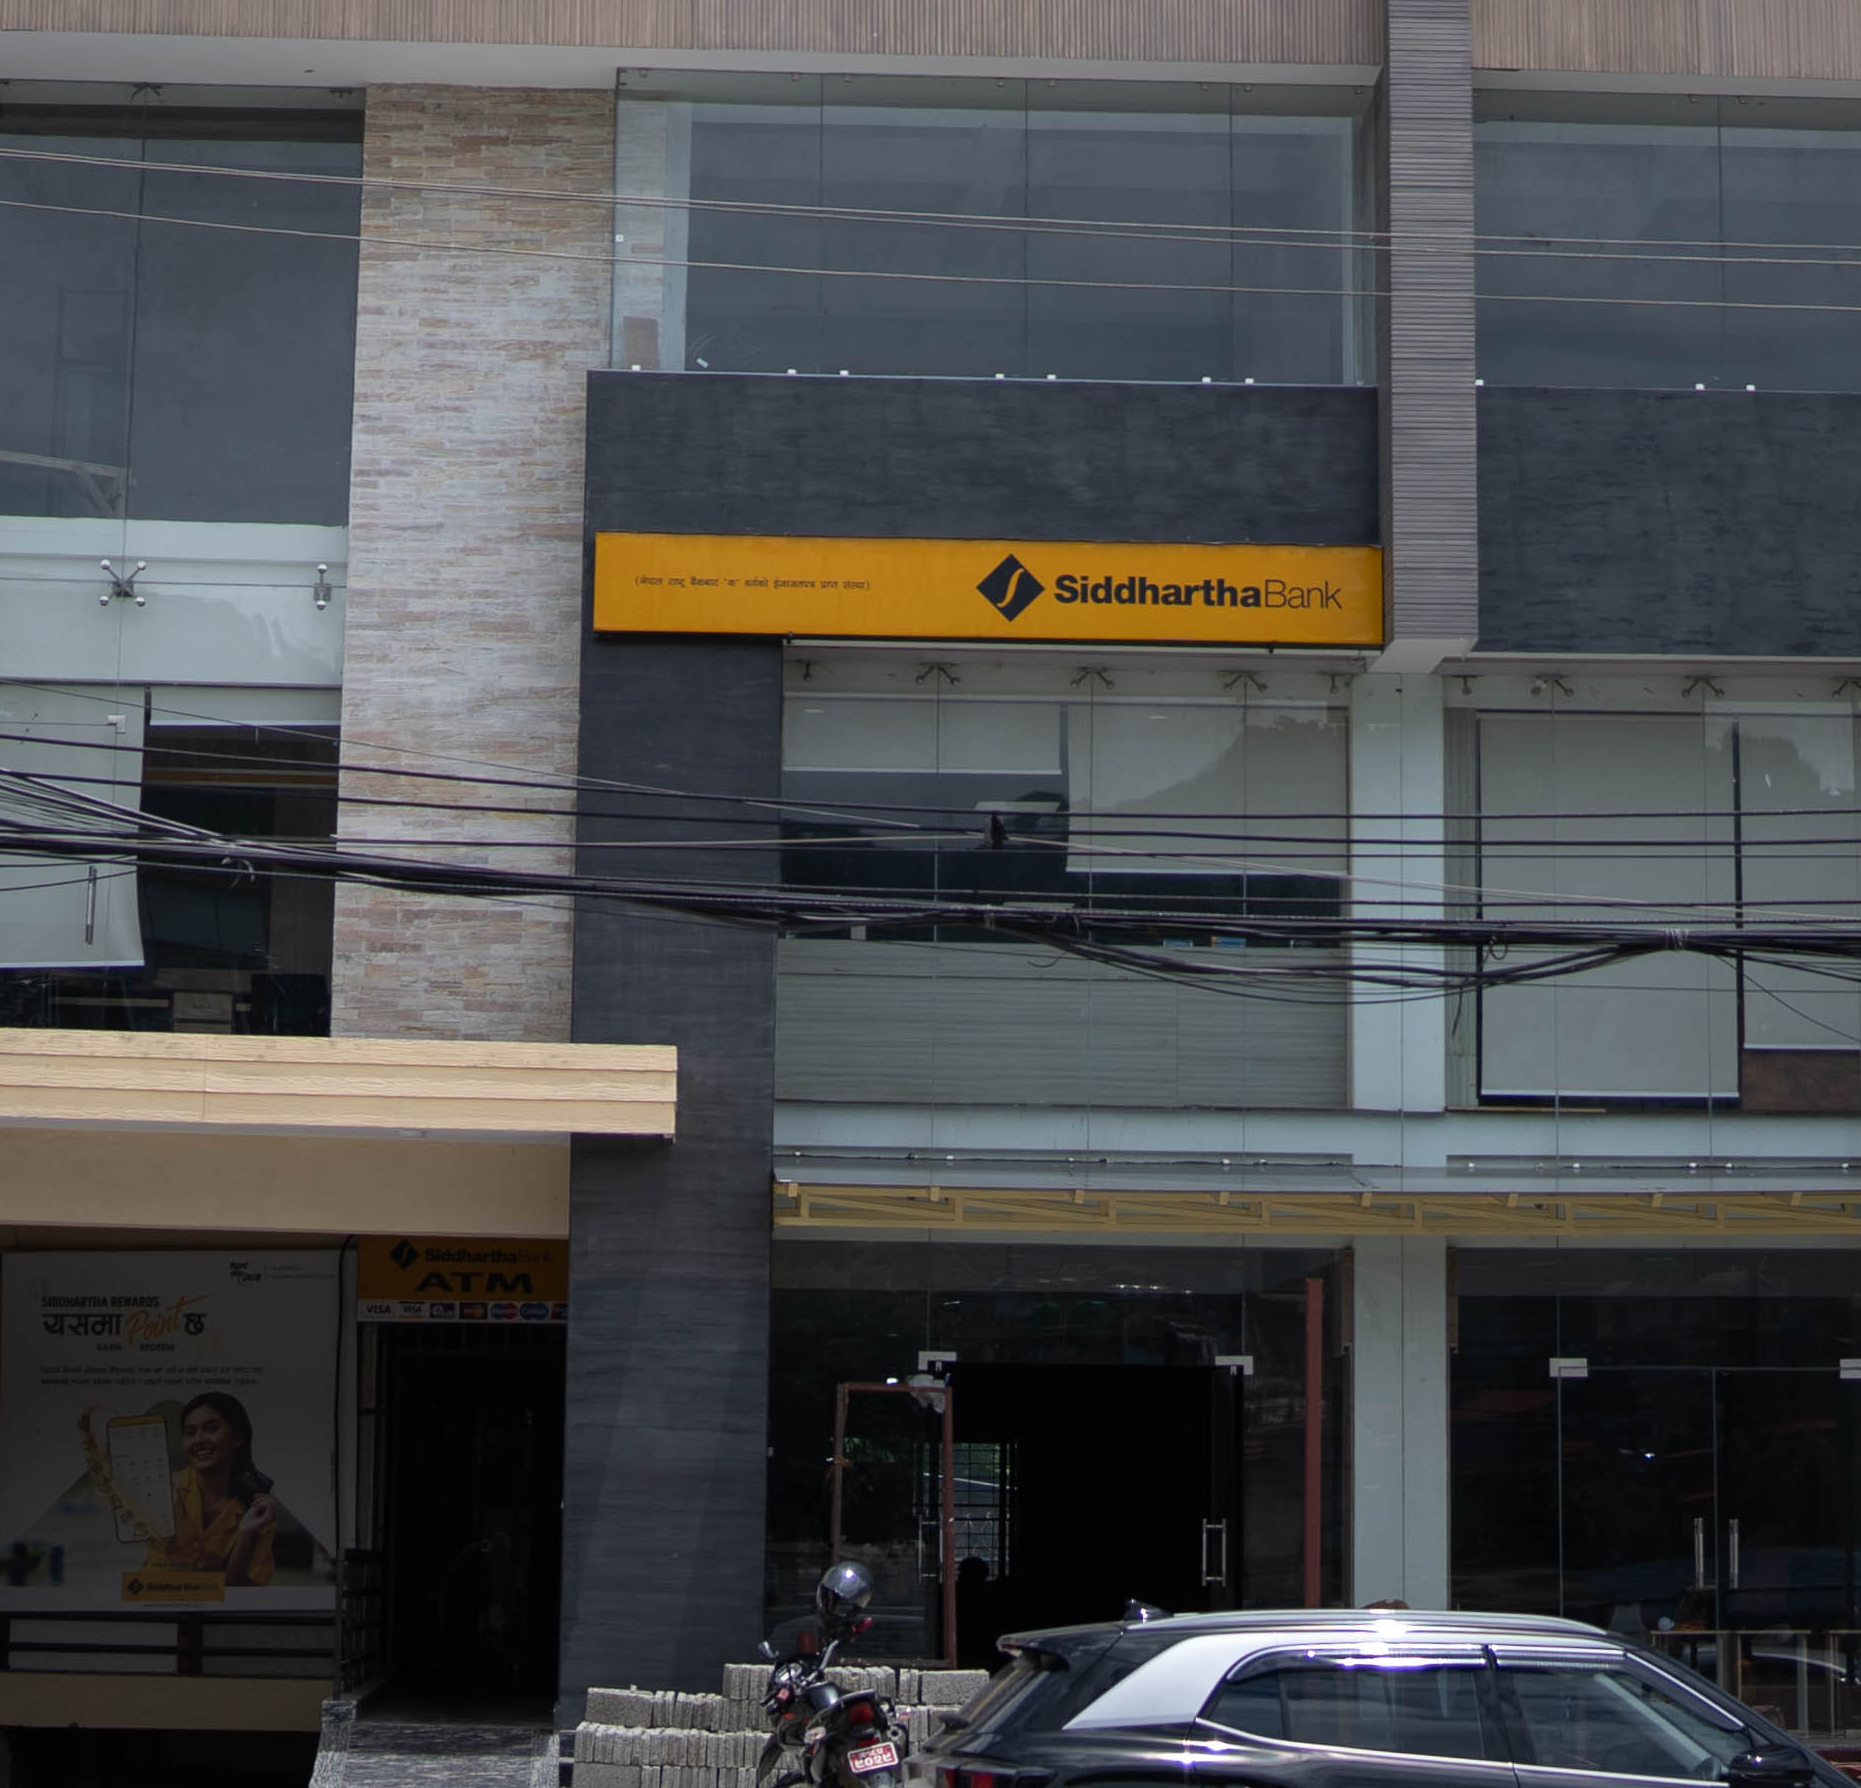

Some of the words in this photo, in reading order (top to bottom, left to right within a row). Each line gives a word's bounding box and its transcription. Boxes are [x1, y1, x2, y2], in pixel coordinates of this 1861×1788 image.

[415, 1271, 533, 1293] ATM
[41, 1295, 108, 1309] SIDDHARTHA
[110, 1295, 160, 1308] REWARDS
[367, 1305, 391, 1314] VISA
[42, 1313, 124, 1337] यसमा
[183, 1313, 207, 1336] छ
